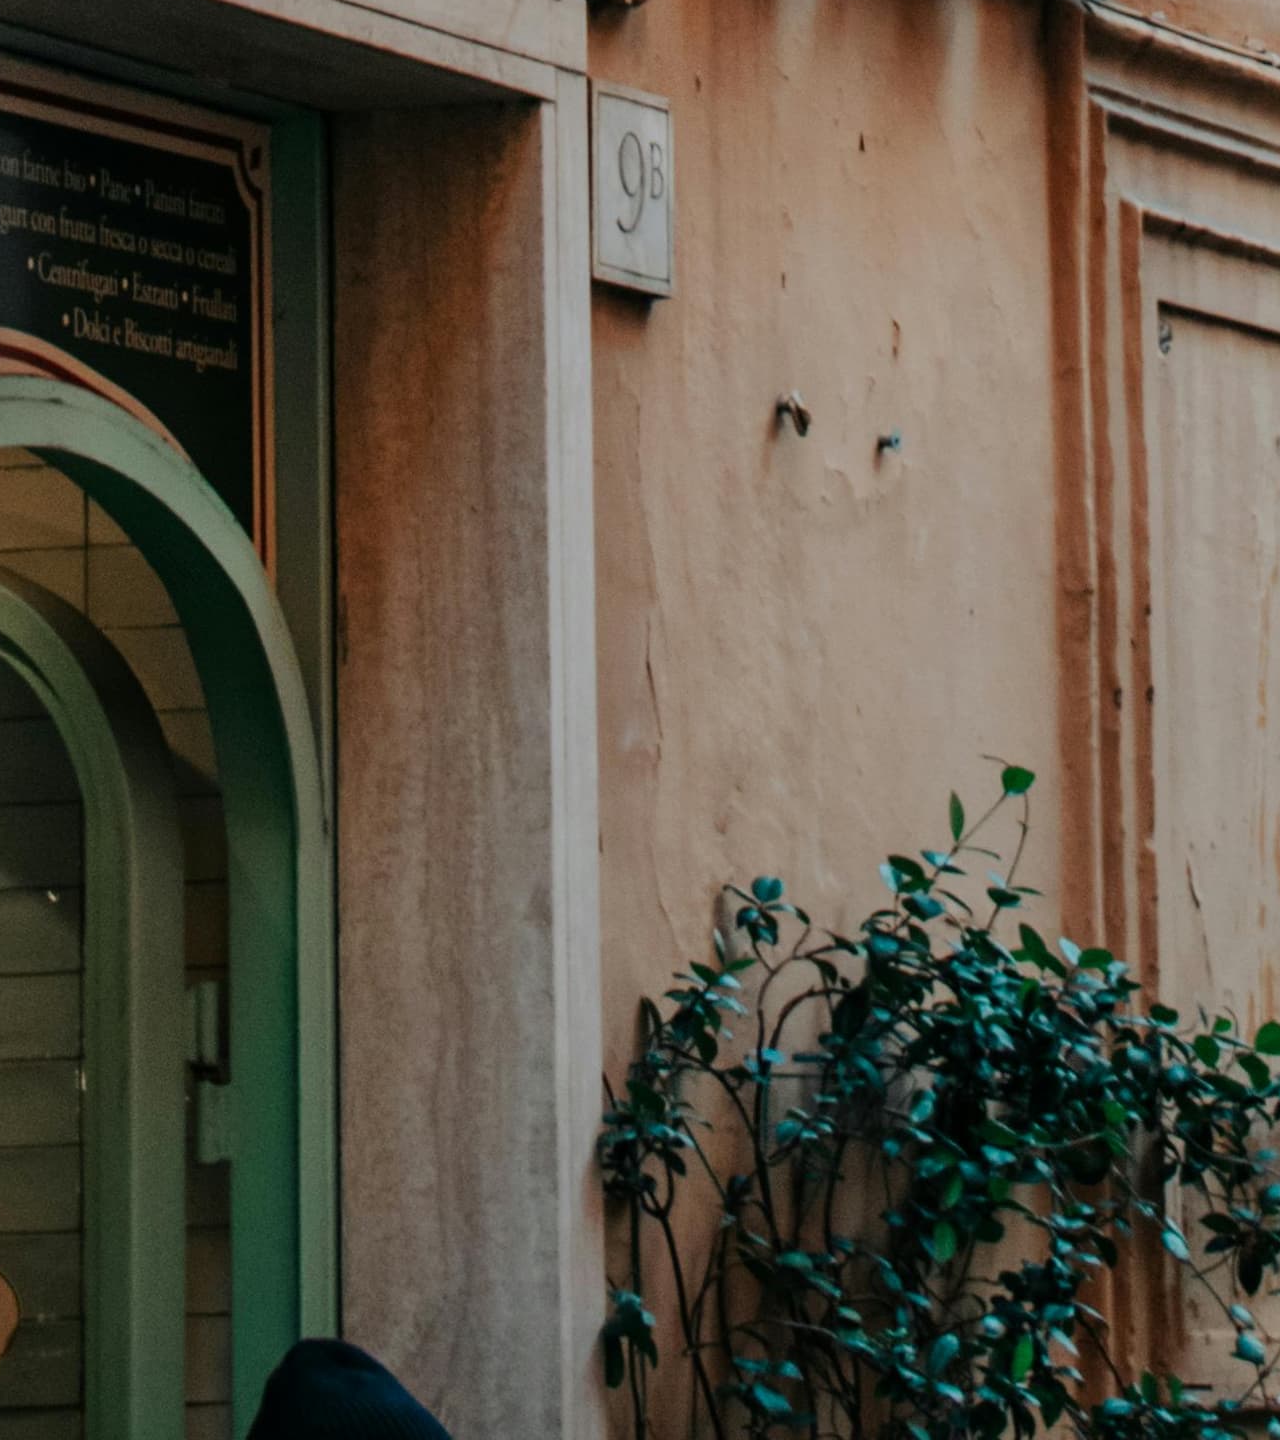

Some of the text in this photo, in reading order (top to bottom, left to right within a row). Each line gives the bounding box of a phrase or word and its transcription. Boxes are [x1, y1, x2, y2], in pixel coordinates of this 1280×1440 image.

[31, 210, 56, 236] con
[60, 206, 97, 245] frutta
[99, 215, 137, 253] fresca
[73, 306, 110, 342] Dolci
[111, 326, 121, 346] e
[124, 318, 173, 357] Biscotti
